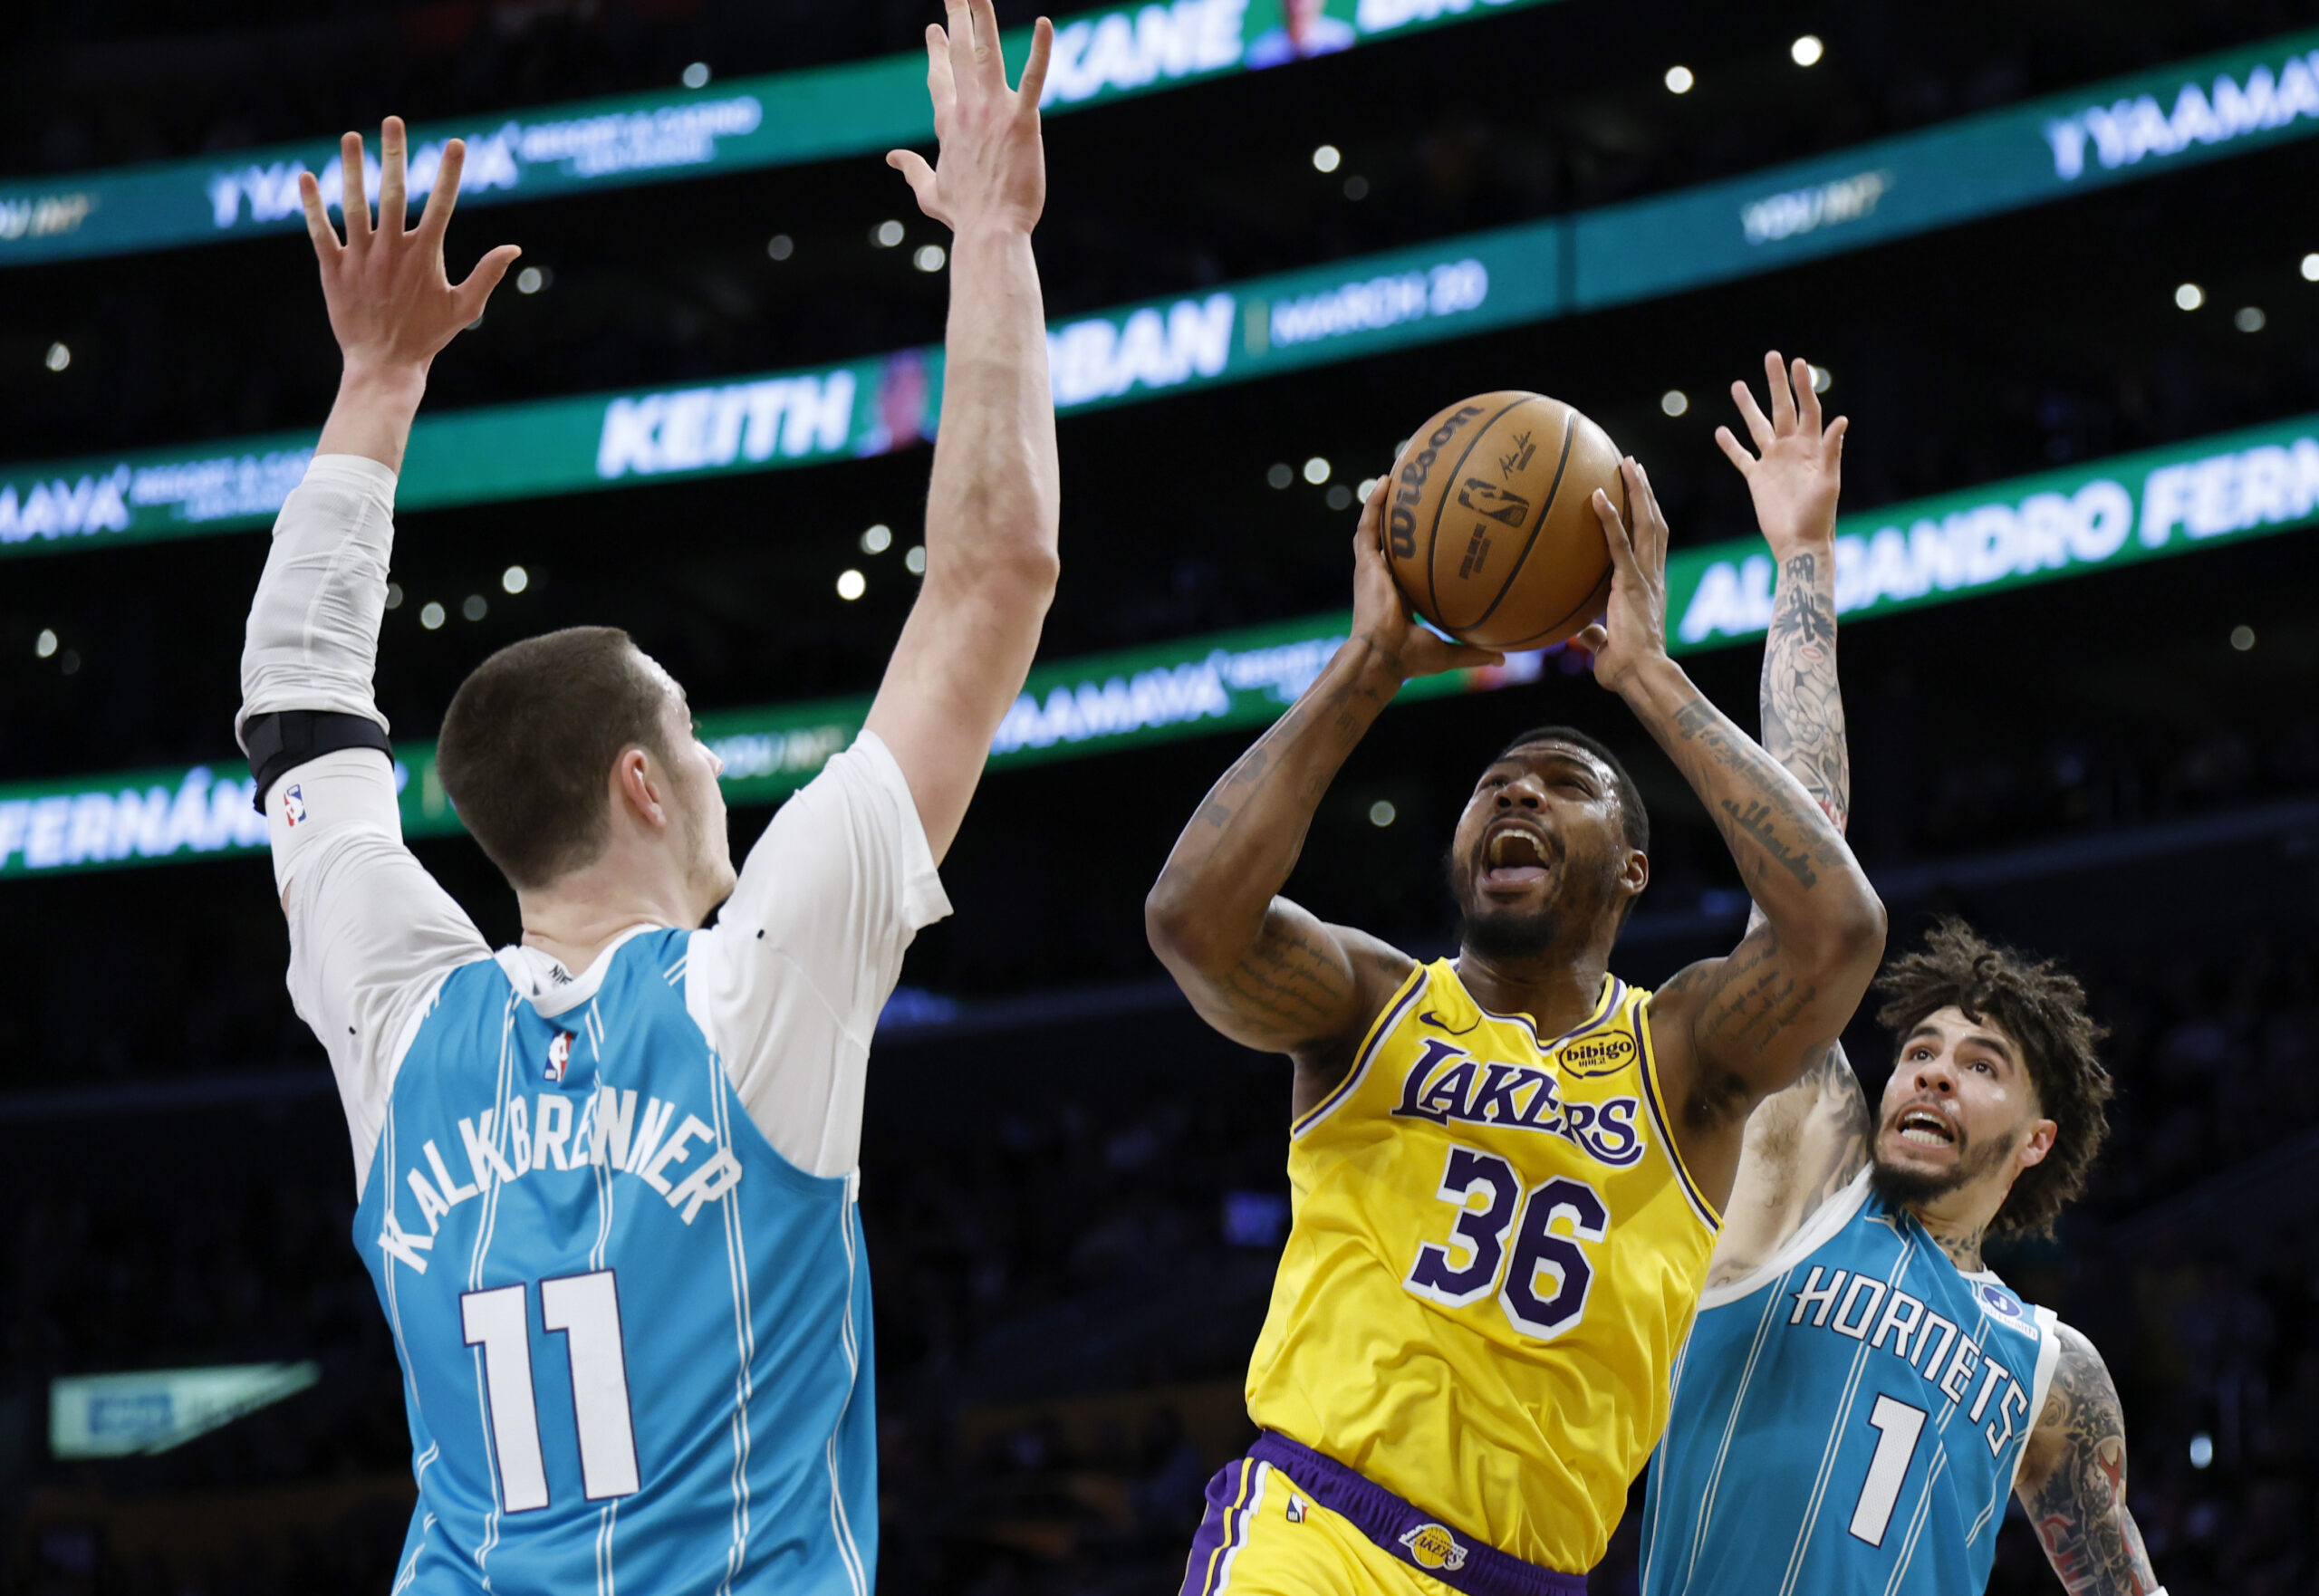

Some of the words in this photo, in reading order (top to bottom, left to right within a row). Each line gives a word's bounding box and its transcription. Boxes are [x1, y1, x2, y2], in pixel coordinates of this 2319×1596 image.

[596, 369, 857, 480] KEITH
[1046, 291, 1236, 408] BAN
[1390, 1036, 1647, 1168] LAKERS
[1566, 1041, 1632, 1062] bibigo
[377, 1085, 742, 1274] KALKBRENNER
[1401, 1142, 1611, 1341] 36
[458, 1268, 640, 1515] 11
[1787, 1265, 2029, 1460] HORNETS
[1848, 1391, 1929, 1551] 1
